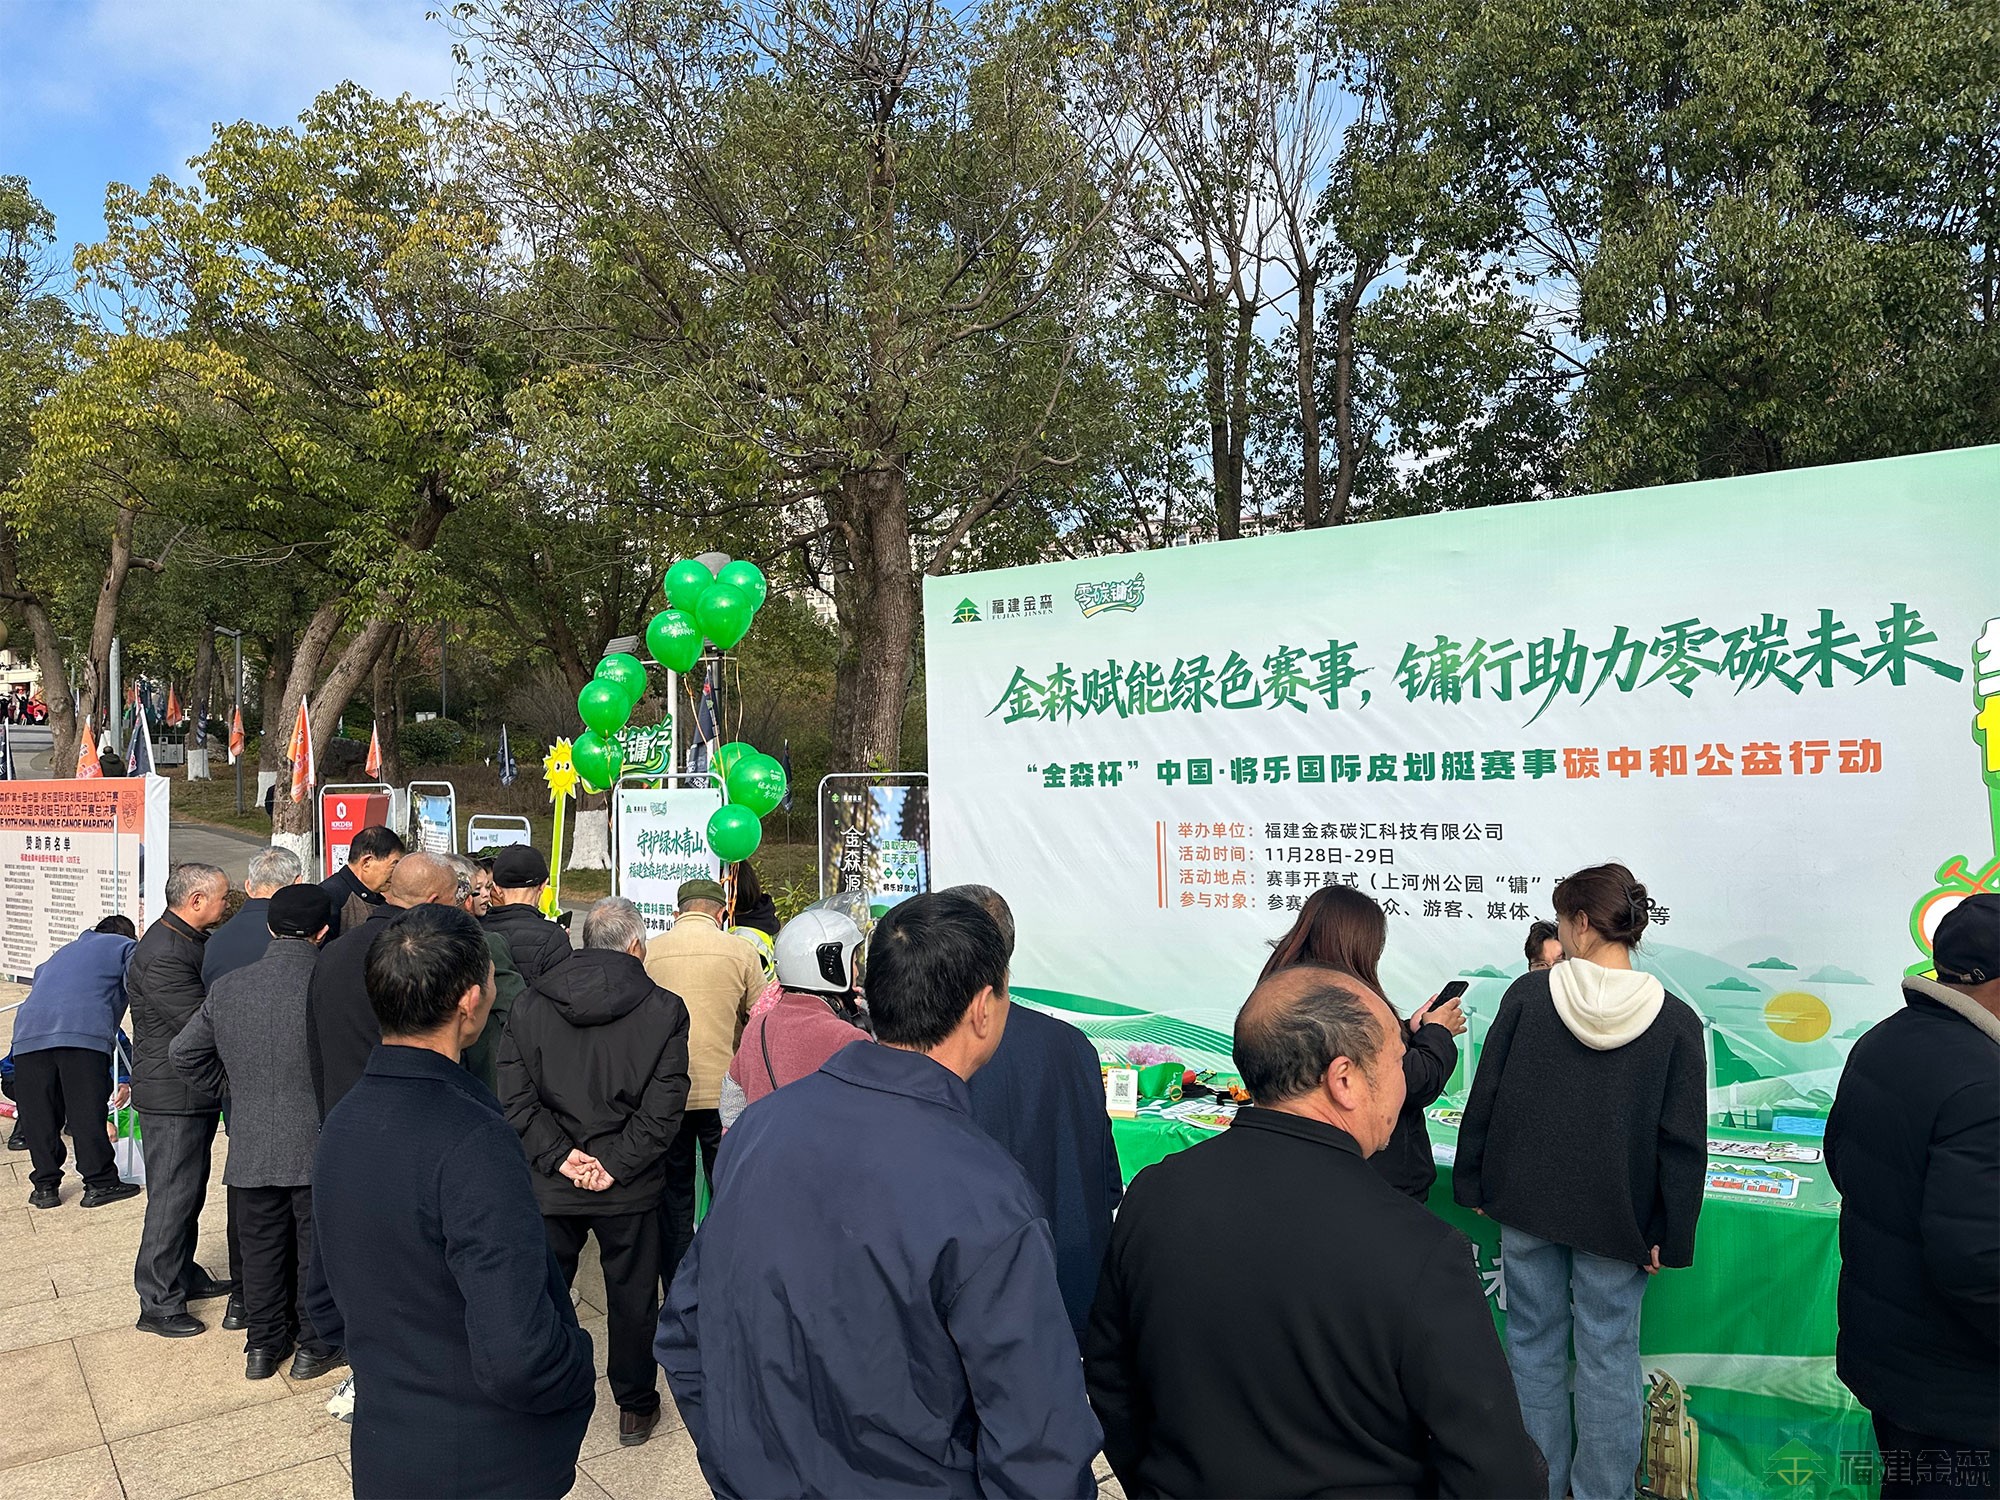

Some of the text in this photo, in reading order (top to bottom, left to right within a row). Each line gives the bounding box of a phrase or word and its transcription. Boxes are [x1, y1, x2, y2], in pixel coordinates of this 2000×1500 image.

[991, 594, 1054, 615] 福建金森
[991, 609, 1054, 620] FUJIAN JINSEN
[61, 819, 82, 829] CANOE
[26, 835, 71, 852] 赞助商名单
[1266, 847, 1396, 866] 11月28日-29日
